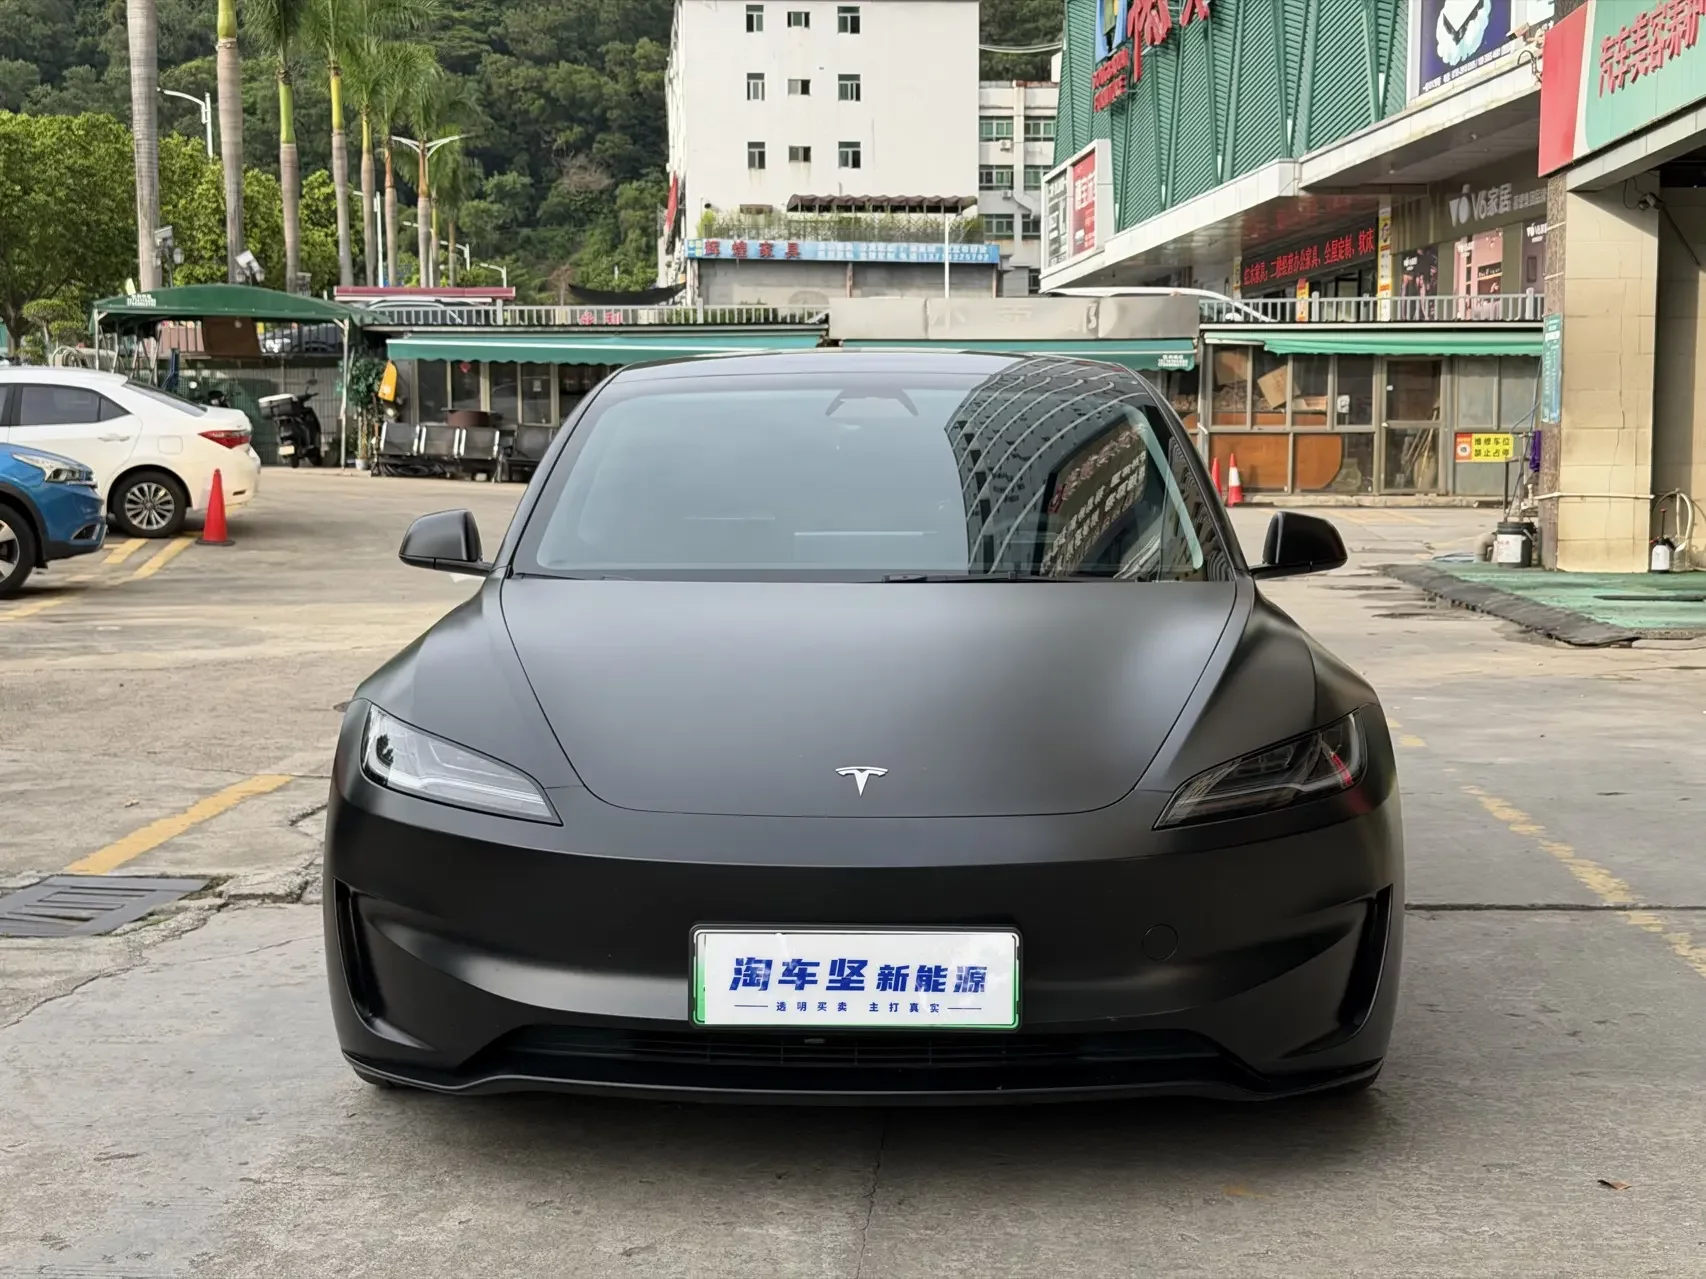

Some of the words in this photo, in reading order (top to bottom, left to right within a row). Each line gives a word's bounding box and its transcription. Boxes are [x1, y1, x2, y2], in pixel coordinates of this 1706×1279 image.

[704, 240, 801, 258] 辉煌家具
[1474, 437, 1510, 446] 维修车位
[776, 1001, 848, 1013] 透明买卖
[868, 1002, 941, 1014] 主打真实
